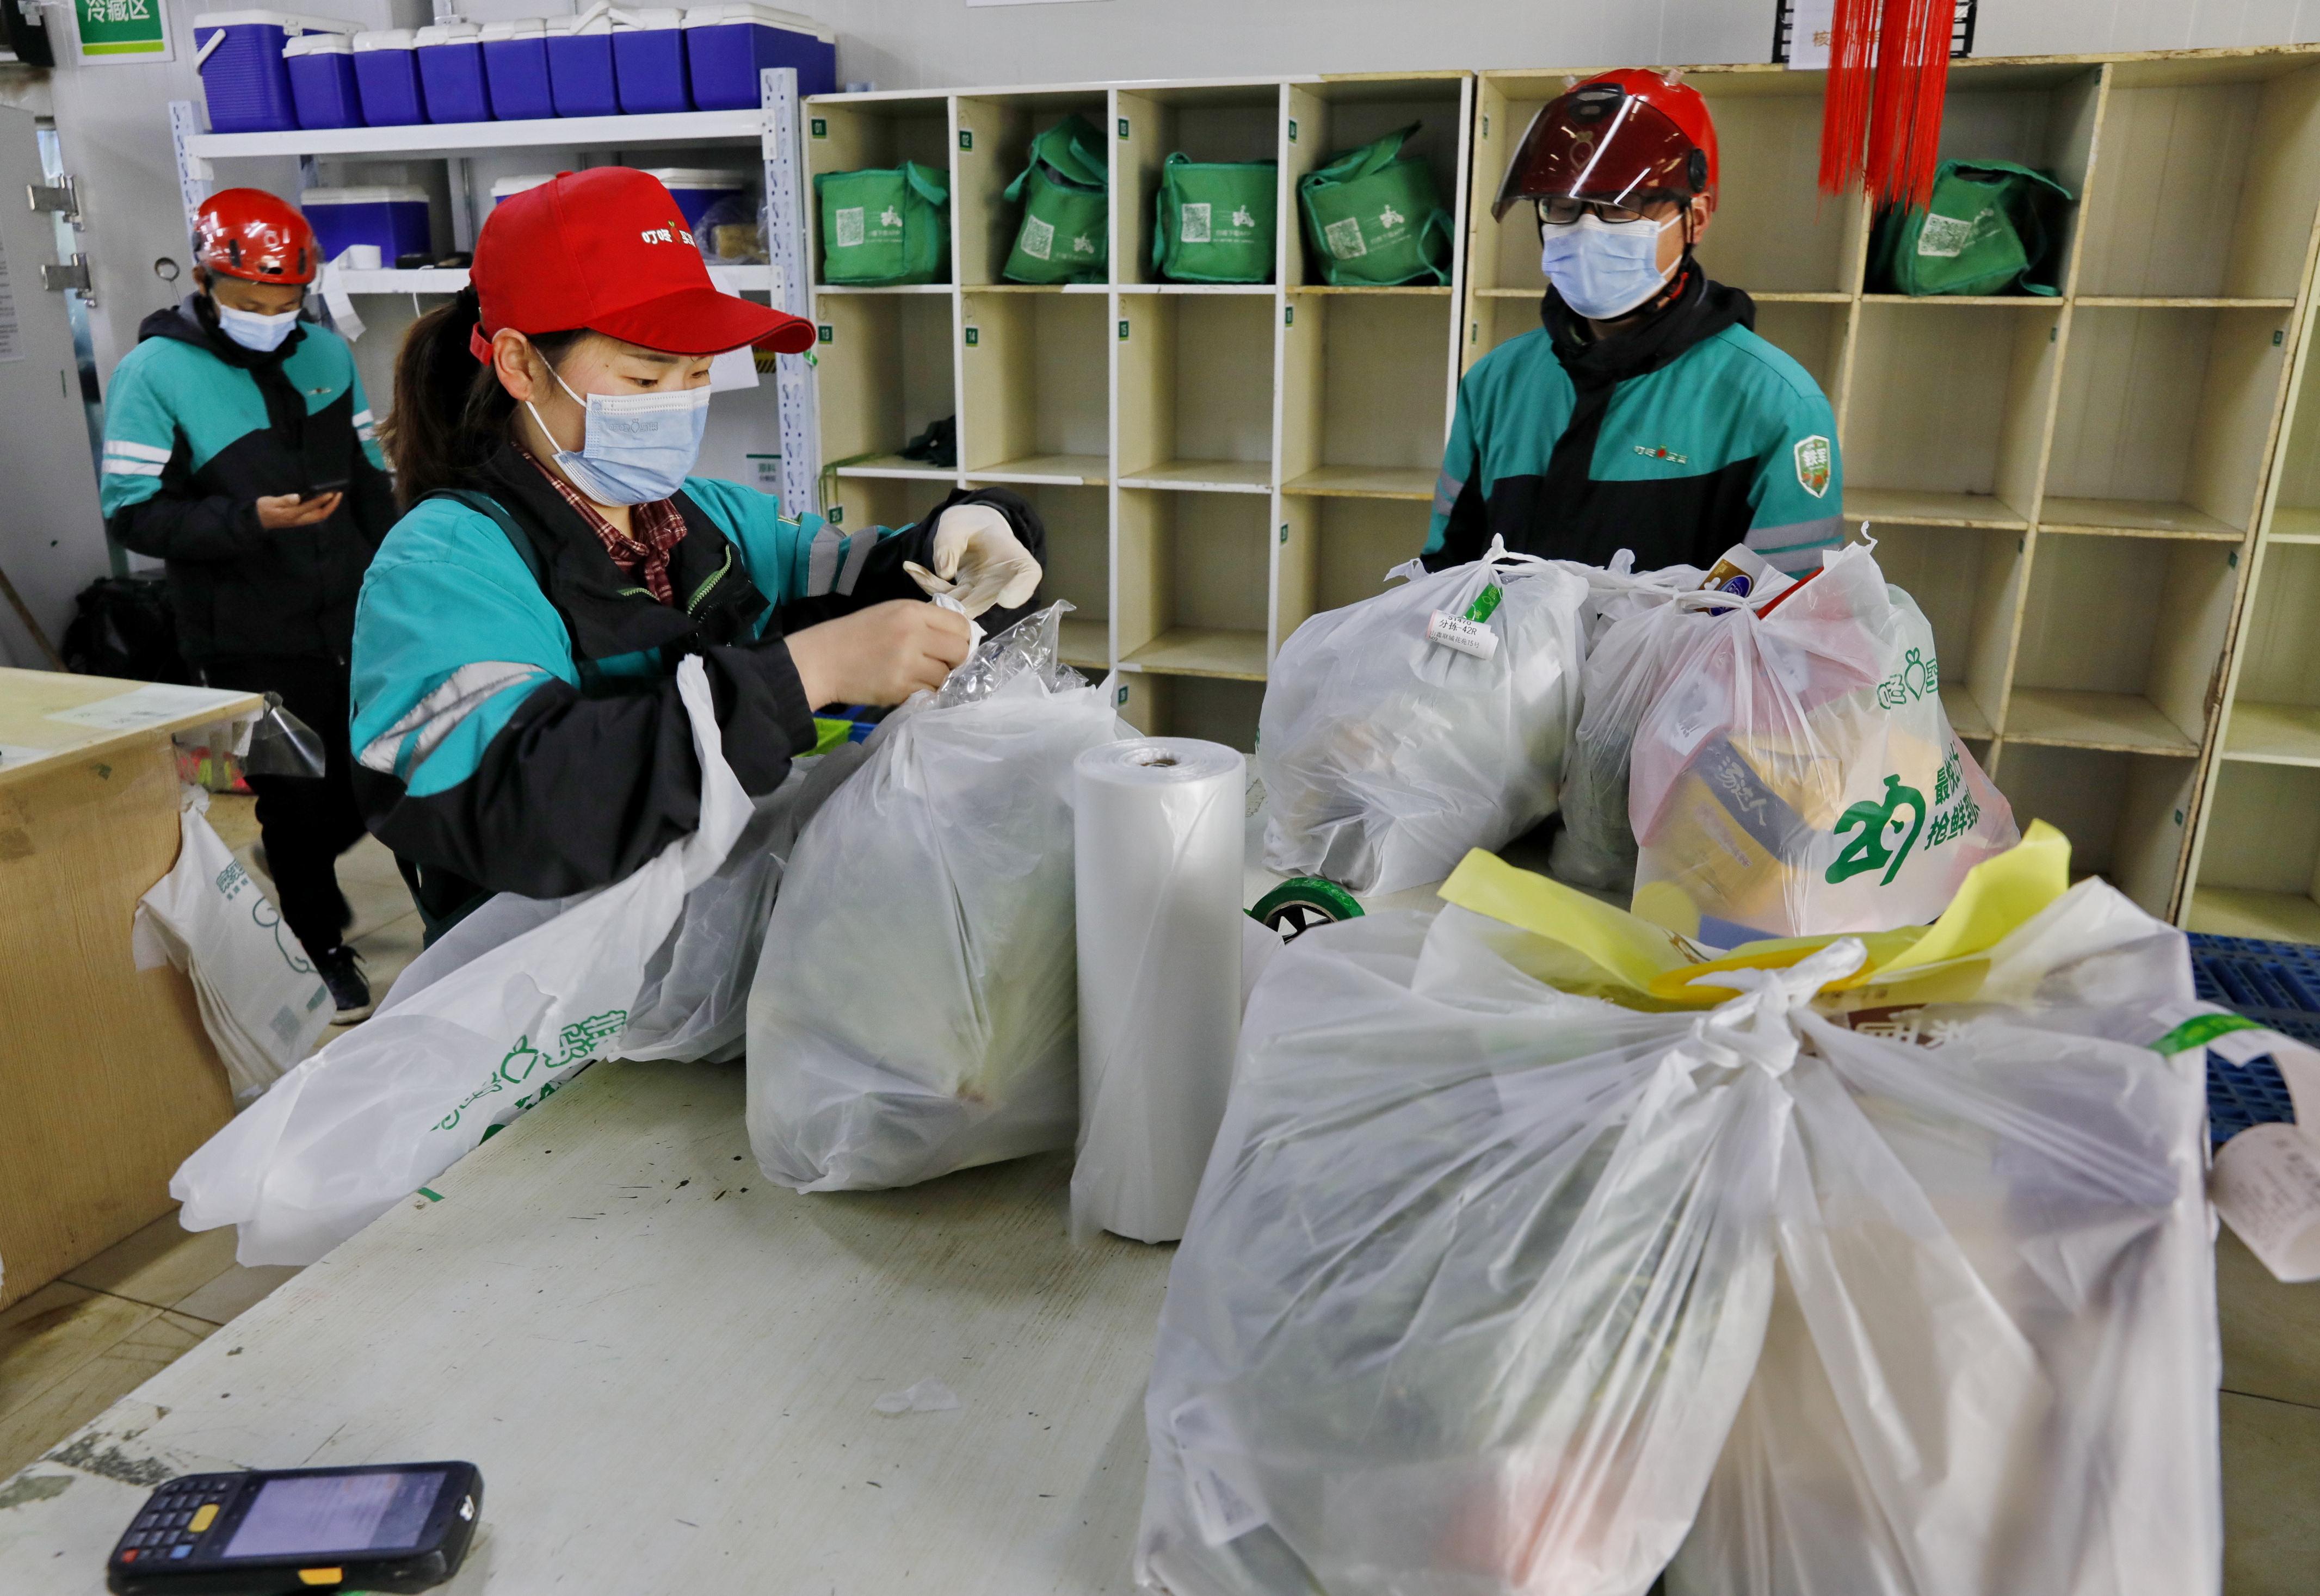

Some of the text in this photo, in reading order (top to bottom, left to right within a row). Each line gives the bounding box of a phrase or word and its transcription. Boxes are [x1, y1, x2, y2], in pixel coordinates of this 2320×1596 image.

[86, 0, 150, 22] 冷藏区
[1438, 618, 1478, 636] 分拣-42R
[1717, 755, 1767, 827] 汤达人
[1924, 783, 1982, 851] 抢鲜到
